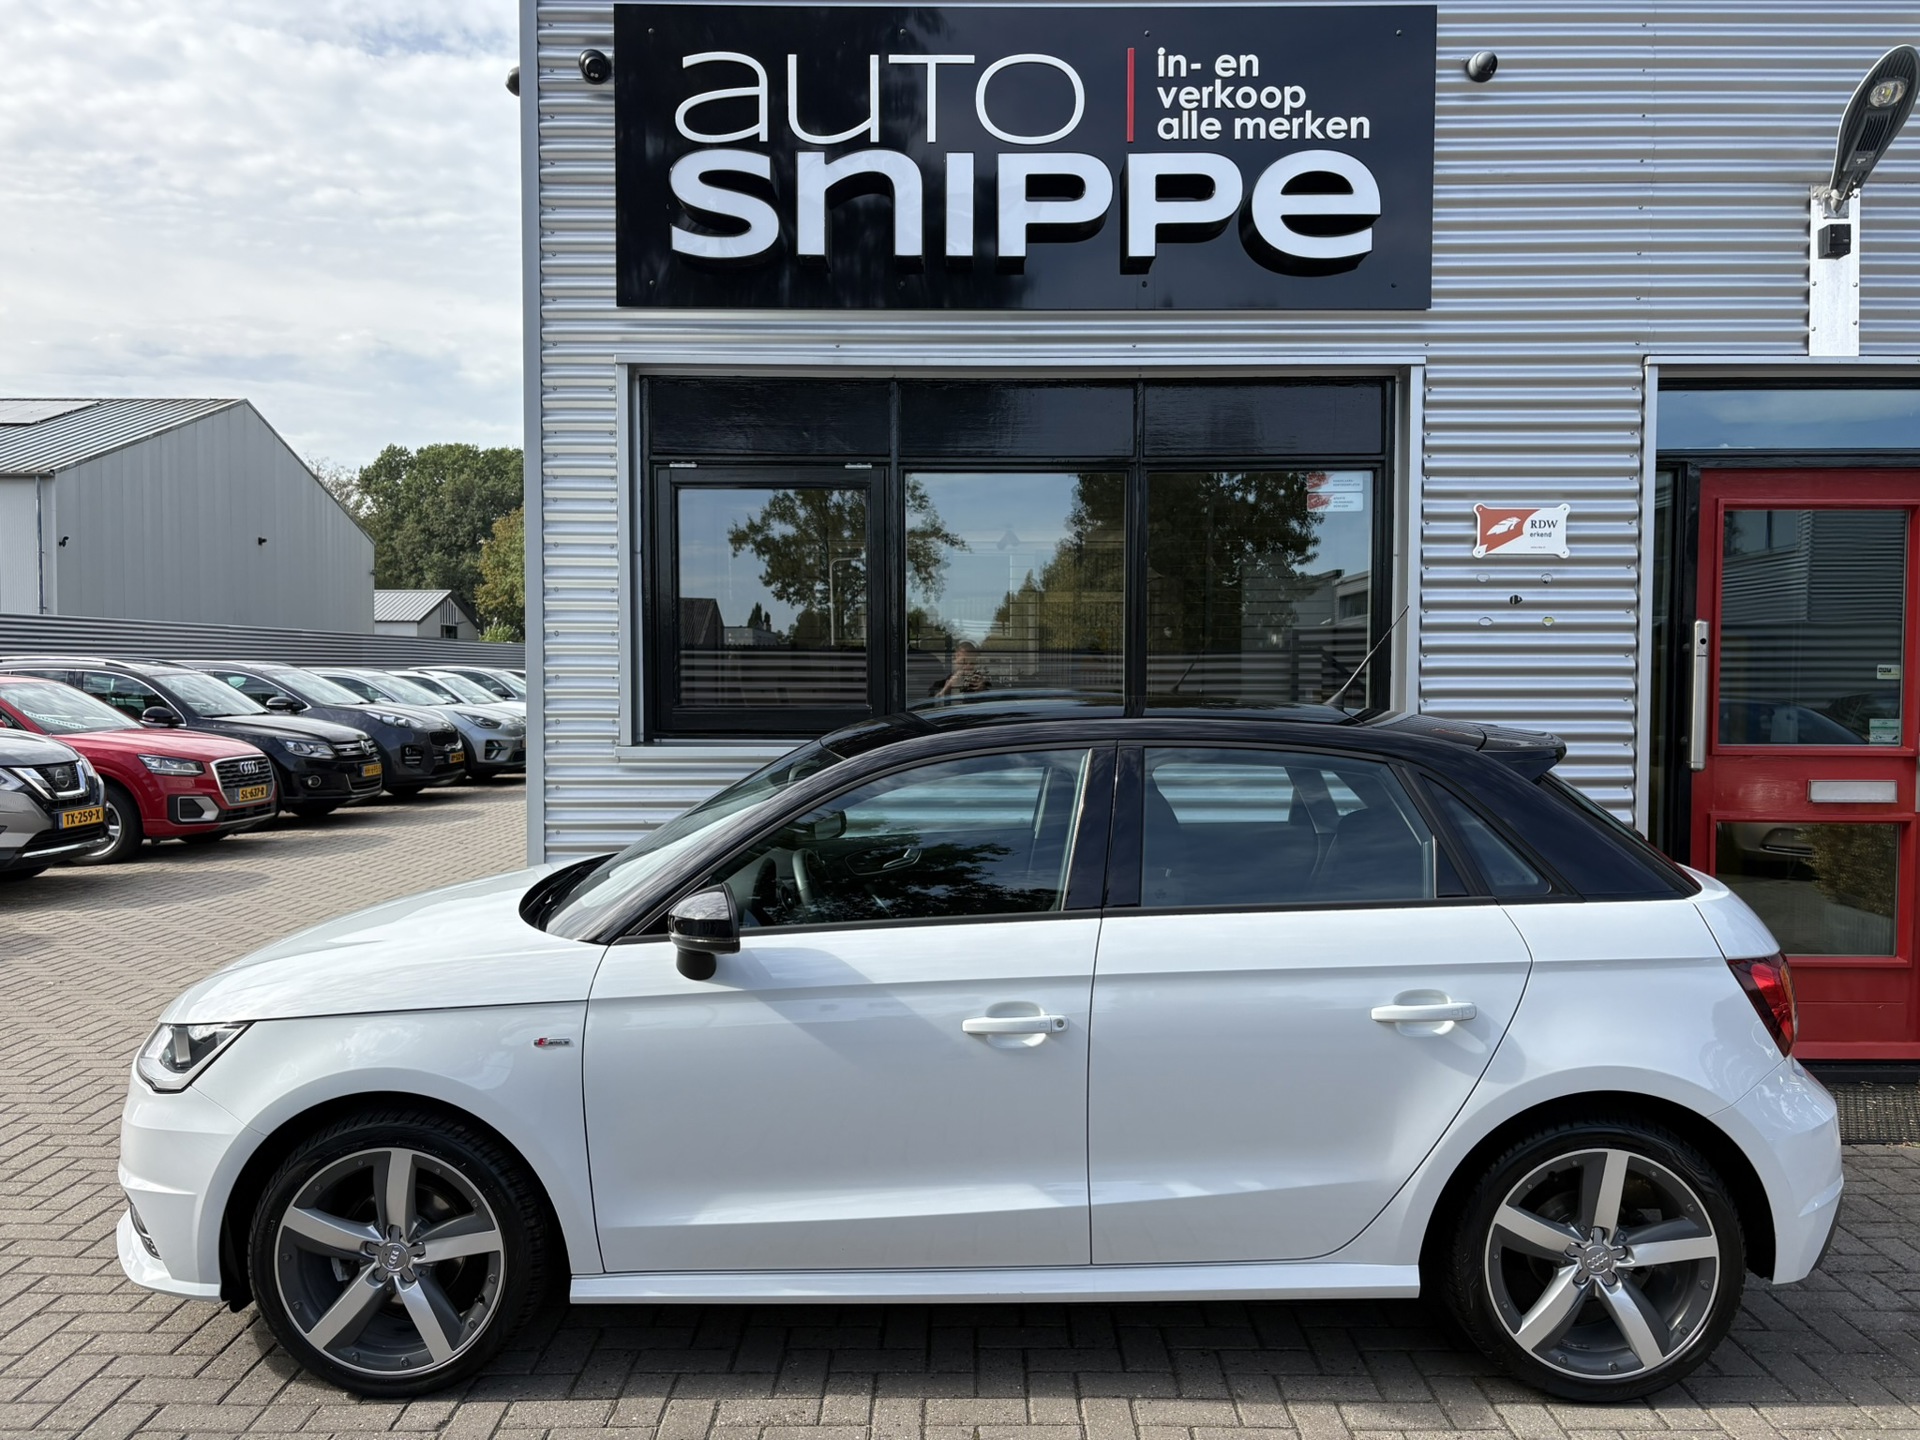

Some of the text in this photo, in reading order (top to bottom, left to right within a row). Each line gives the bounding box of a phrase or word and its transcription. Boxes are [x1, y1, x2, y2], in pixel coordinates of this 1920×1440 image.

[1157, 47, 1260, 78] in- en
[1157, 79, 1306, 115] verkoop
[1157, 110, 1370, 140] alle merken
[1530, 519, 1558, 529] RDW
[65, 808, 101, 826] TX-259-X
